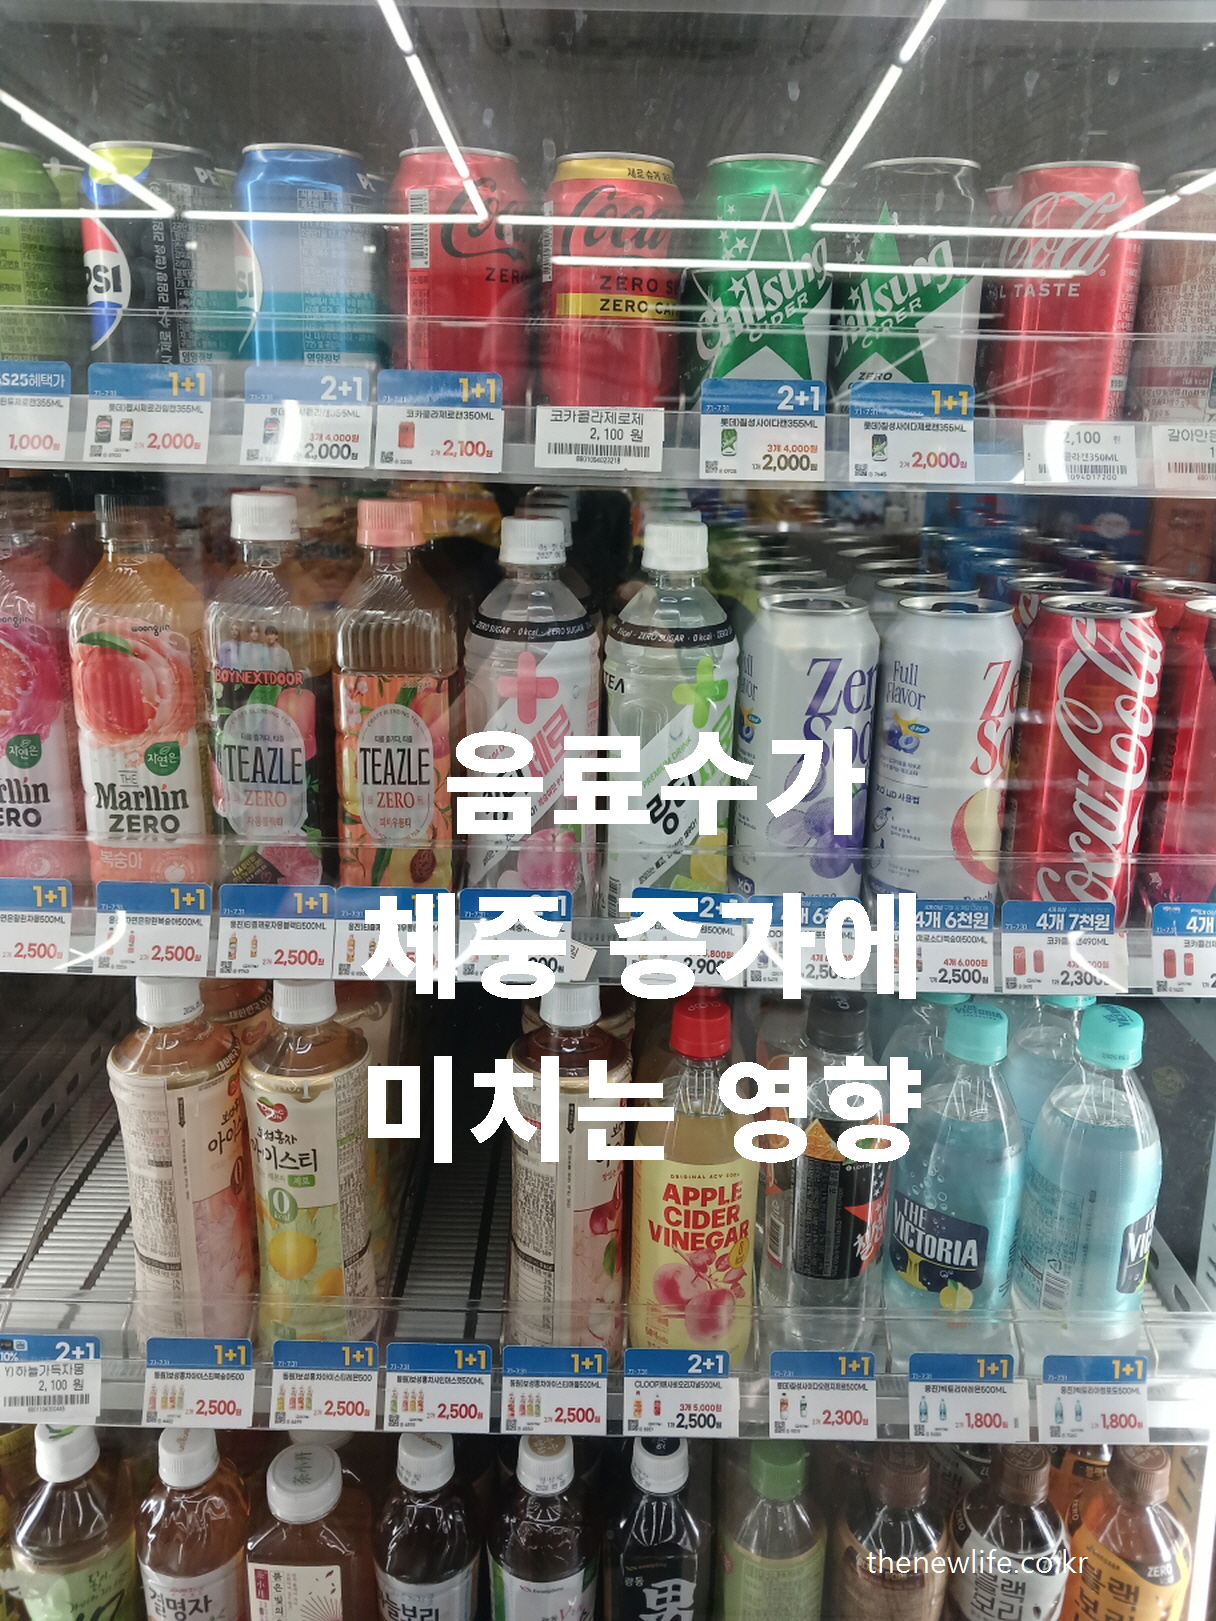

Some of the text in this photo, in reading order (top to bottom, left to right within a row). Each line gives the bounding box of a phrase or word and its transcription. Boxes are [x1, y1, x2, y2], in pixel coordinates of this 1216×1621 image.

[600, 275, 658, 292] ZERO
[1014, 283, 1081, 298] TASTE
[599, 298, 648, 313] ZERO
[0, 373, 65, 389] S25혜택가
[169, 372, 206, 397] 1+1
[858, 372, 893, 382] ZERO
[320, 375, 363, 401] 2+1
[459, 377, 496, 403] 1+1
[777, 385, 820, 411] 2+1
[931, 390, 968, 416] 1+1
[550, 409, 645, 426] 코카콜라제로제
[630, 429, 643, 443] 원
[214, 669, 304, 686] BOYNEXTDOOR
[892, 660, 918, 687] Full
[886, 682, 926, 712] Flavor
[147, 751, 178, 768] 자연은
[223, 744, 303, 786] TEAZLE
[359, 747, 431, 787] TEAZLE
[120, 774, 137, 785] THE
[95, 781, 190, 812] Marllin
[244, 789, 288, 809] ZERO
[376, 791, 415, 809] ZERO
[108, 814, 181, 835] ZERO
[100, 850, 143, 870] 복숭아
[33, 885, 68, 908] 1+1
[170, 887, 206, 911] 1+1
[293, 892, 328, 916] 1+1
[945, 911, 989, 930] 6천원
[1036, 913, 1110, 932] 4개 7천원
[1185, 916, 1215, 934] 4개
[662, 1183, 743, 1208] APPLE
[663, 1204, 741, 1230] CIDER
[902, 1197, 928, 1226] THE
[648, 1219, 750, 1252] VINEGAR
[893, 1202, 979, 1267] VICTORIA
[55, 1341, 96, 1361] 2+1
[213, 1344, 247, 1366] 1+1
[342, 1346, 374, 1367] 1+1
[454, 1349, 486, 1370] 1+1
[571, 1353, 603, 1374] 1+1
[688, 1354, 724, 1374] 2+1
[838, 1356, 870, 1376] 1+1
[977, 1358, 1009, 1379] 1+1
[1112, 1359, 1144, 1380] 1+1
[73, 1378, 84, 1392] 원
[679, 1403, 691, 1412] 3개
[1147, 1562, 1173, 1578] ZERO
[148, 1587, 213, 1621] 결명자
